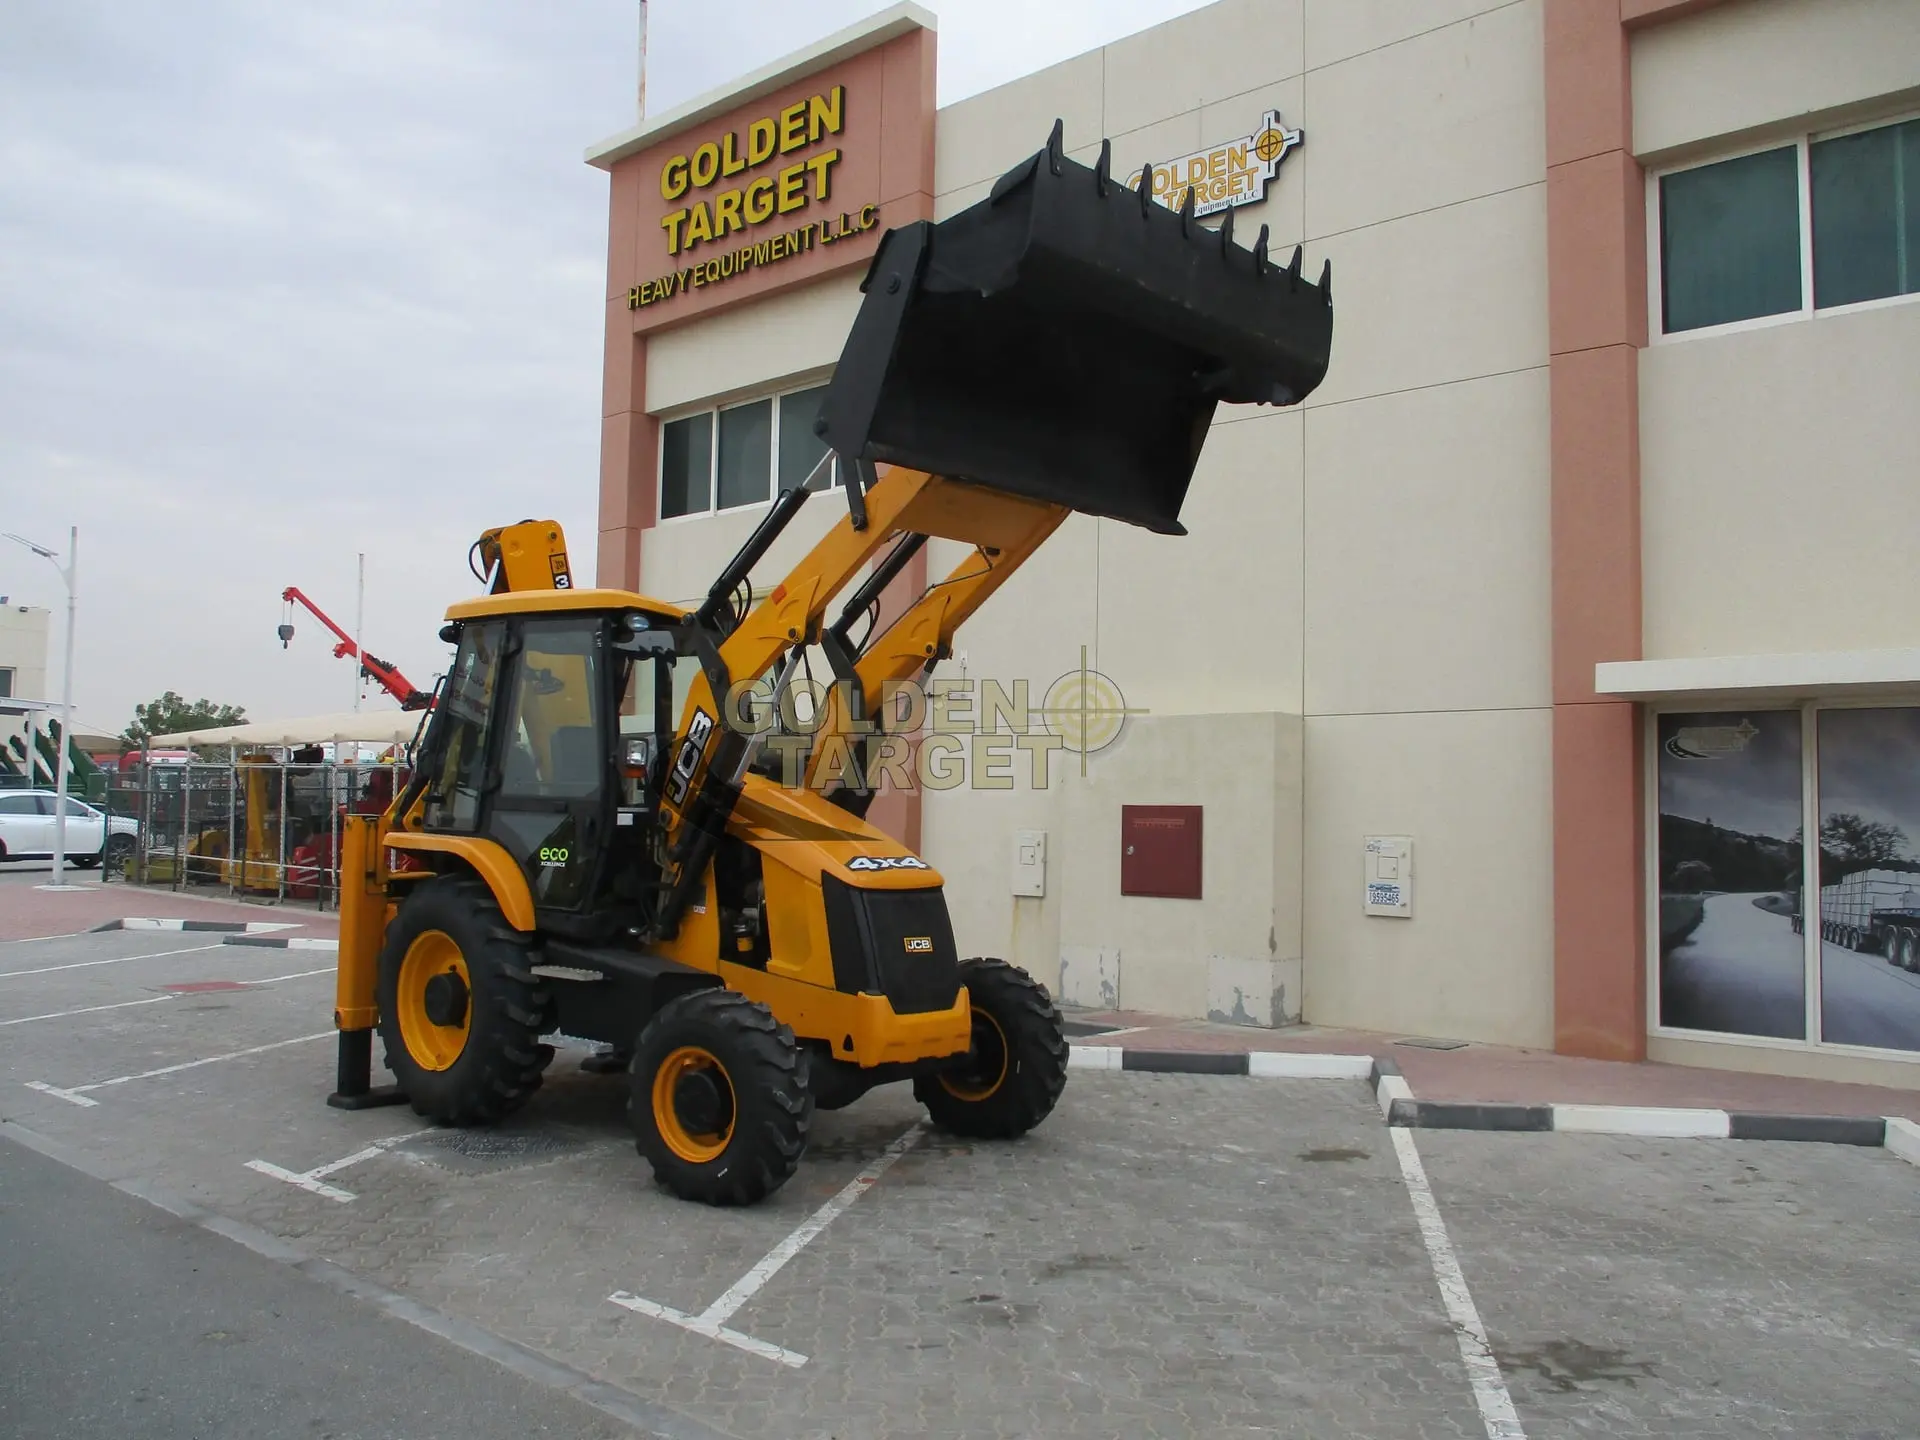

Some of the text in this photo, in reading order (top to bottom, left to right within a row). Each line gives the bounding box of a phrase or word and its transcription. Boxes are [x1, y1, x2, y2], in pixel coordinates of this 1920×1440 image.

[660, 85, 845, 200] GOLDEN
[661, 148, 841, 255] TARGET
[628, 270, 690, 310] HEAVY
[693, 223, 816, 287] EQUIPMENT
[669, 711, 712, 803] JCB
[540, 847, 569, 861] eco
[907, 940, 930, 950] JCB
